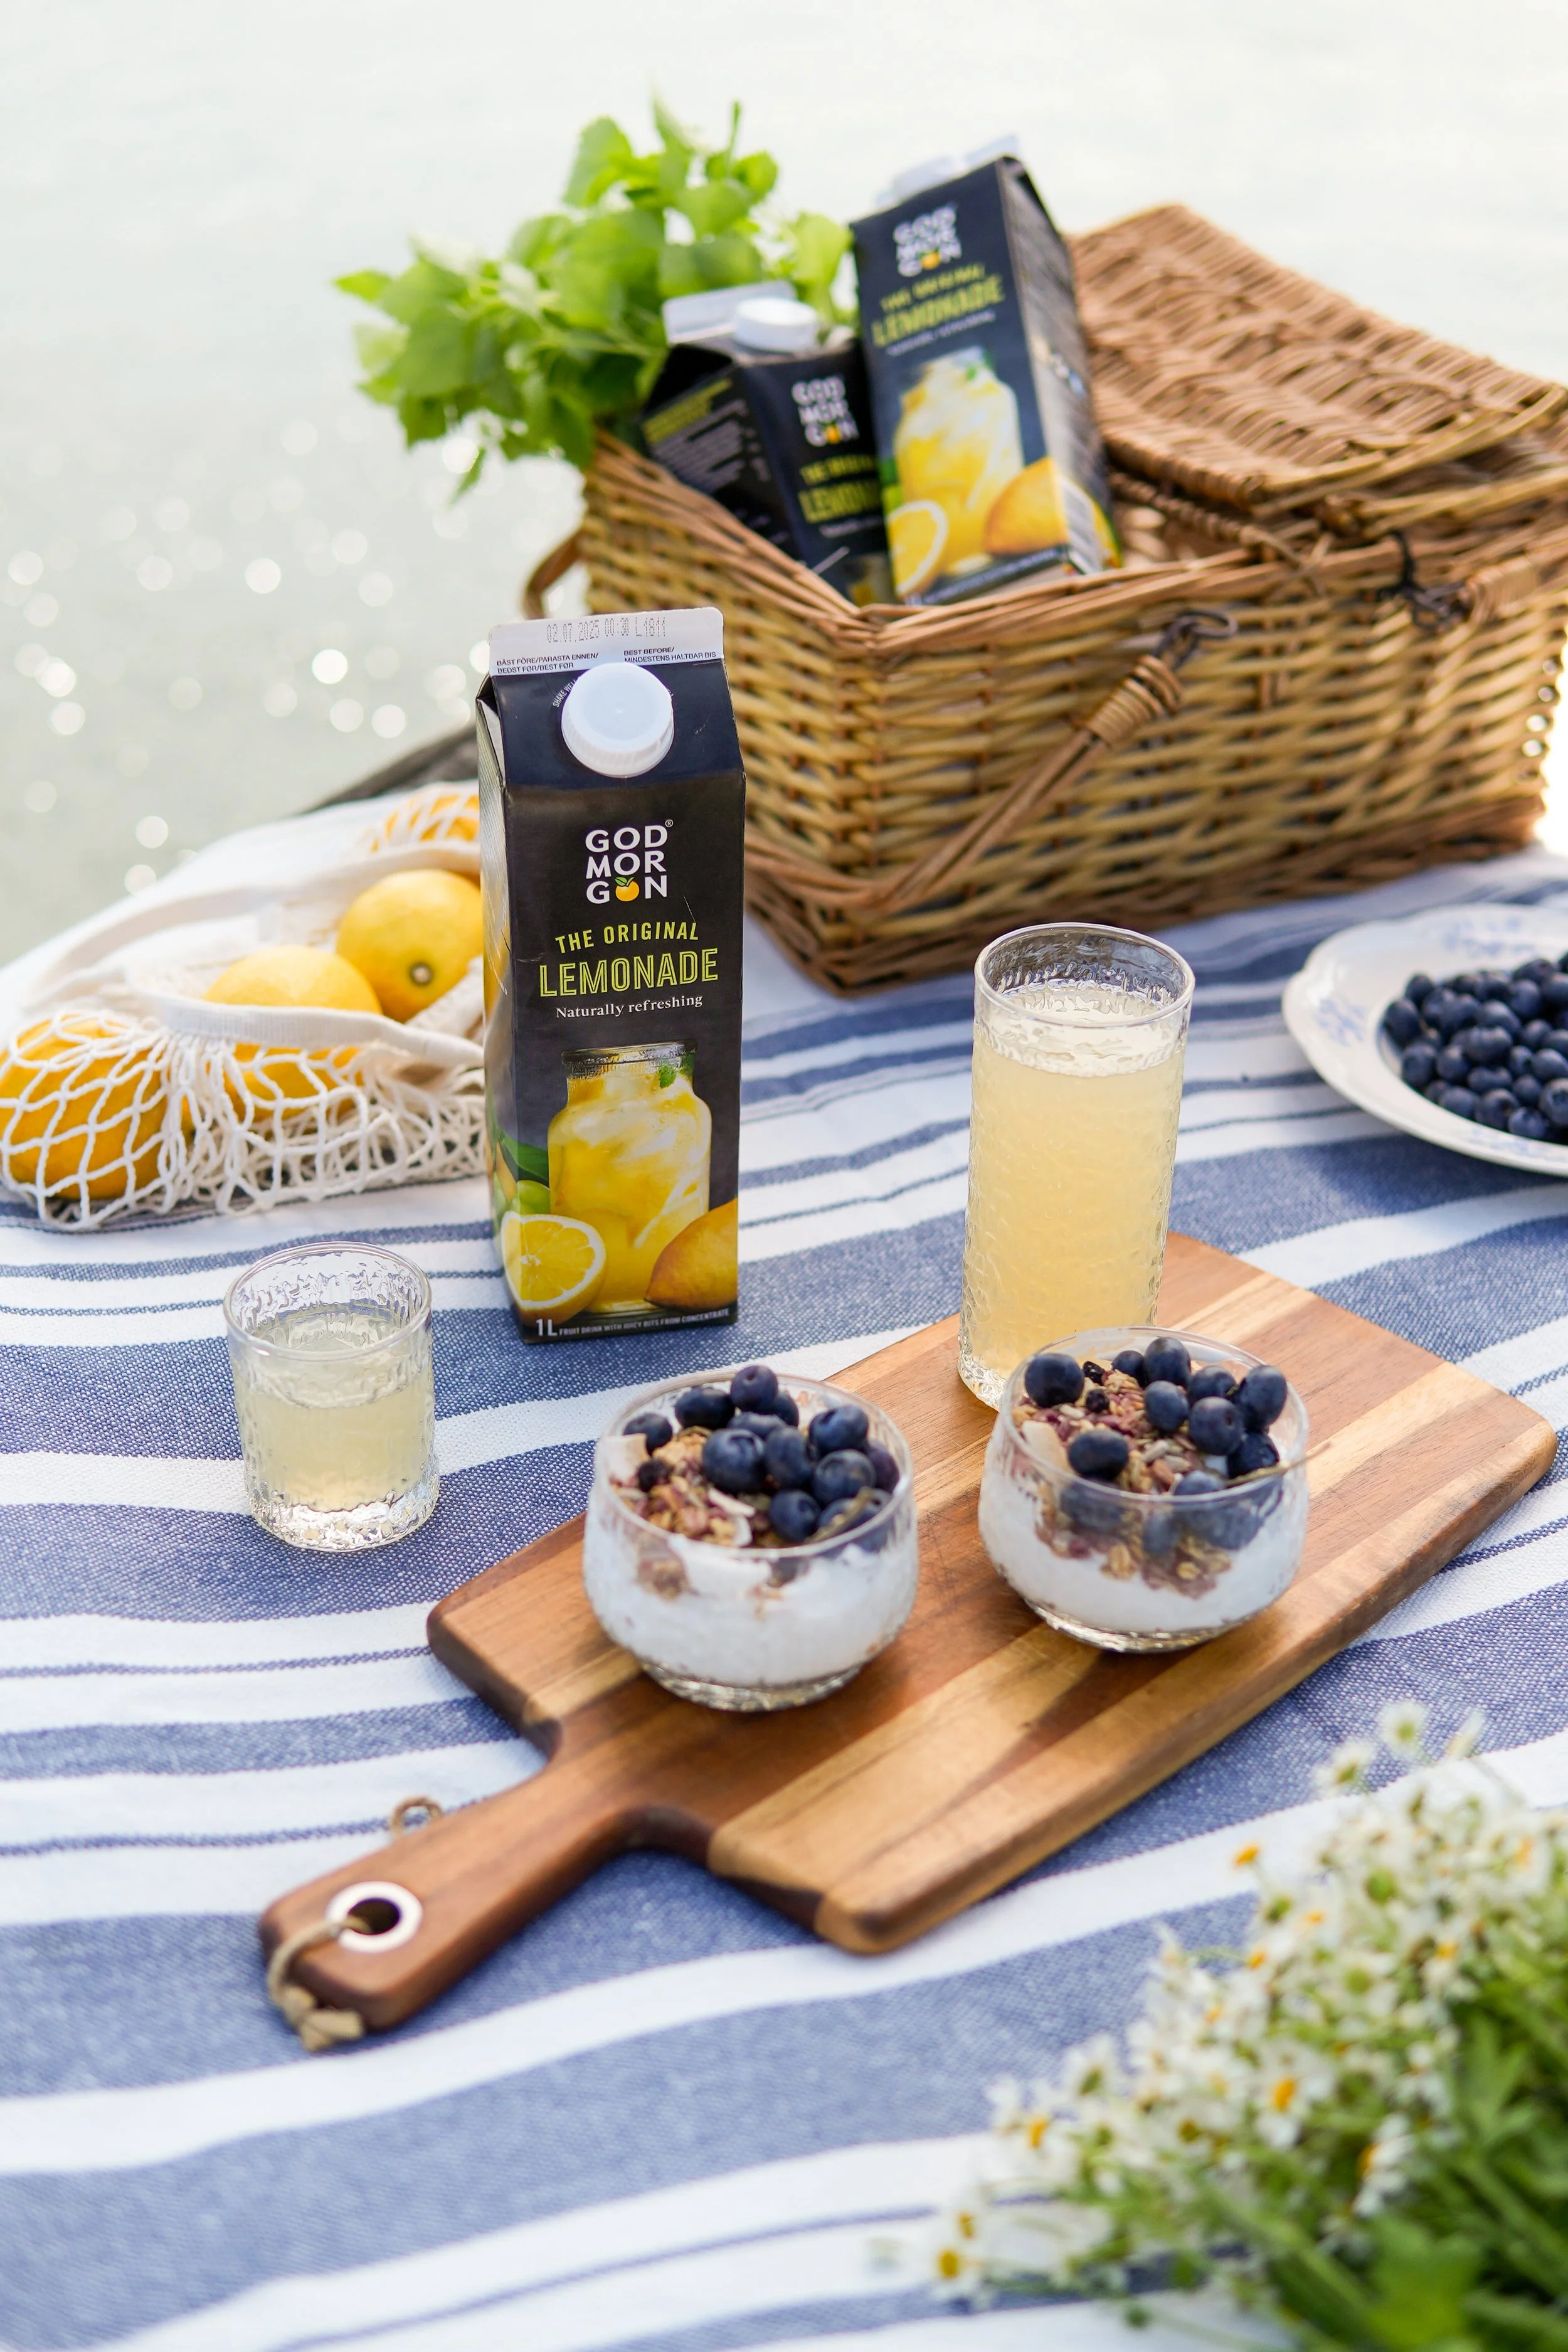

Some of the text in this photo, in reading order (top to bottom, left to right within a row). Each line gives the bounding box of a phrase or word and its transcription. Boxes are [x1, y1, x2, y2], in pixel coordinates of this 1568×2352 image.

[497, 658, 515, 667] BÄST
[624, 655, 670, 664] MINDESTENS
[671, 652, 704, 660] HALTBAR
[553, 689, 567, 707] SHAKE
[585, 825, 669, 852] GOD
[586, 850, 667, 879] MOR
[555, 921, 699, 954] THE ORIGINAL
[539, 948, 719, 997] LEMONADE
[556, 995, 703, 1019] Naturally refreshing
